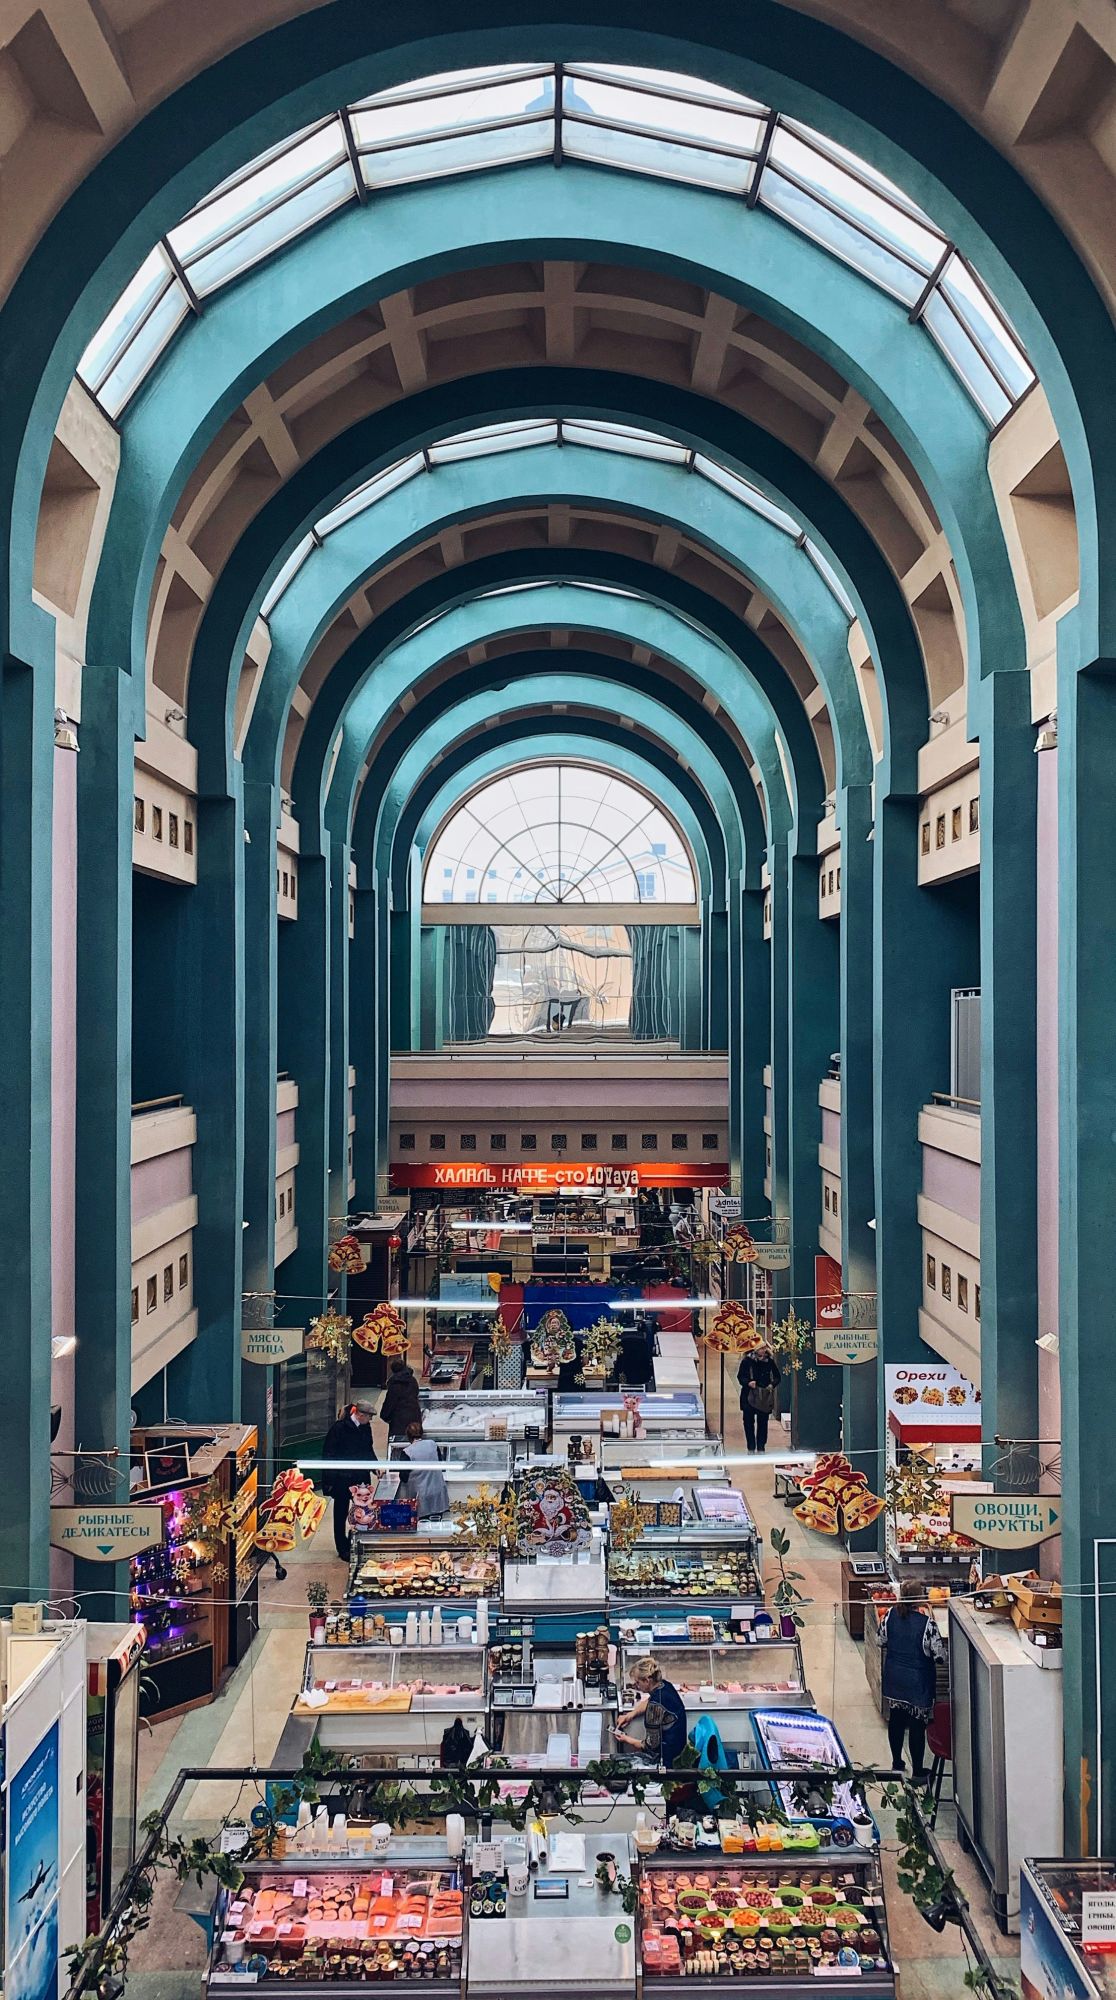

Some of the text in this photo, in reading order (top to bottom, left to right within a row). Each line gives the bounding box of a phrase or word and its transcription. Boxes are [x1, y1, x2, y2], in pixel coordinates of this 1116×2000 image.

[248, 1334, 283, 1343] МЯСО,
[833, 1333, 870, 1341] РЫБНЫЕ
[246, 1344, 285, 1355] ПТИЦА
[896, 1370, 947, 1382] Орехи
[974, 1503, 1042, 1518] ОВОЩИ,
[78, 1514, 134, 1525] РЫБНЫЕ
[973, 1519, 1044, 1532] ФРУКТЫ
[61, 1526, 150, 1539] ДЕЛИКАТЕСЫ
